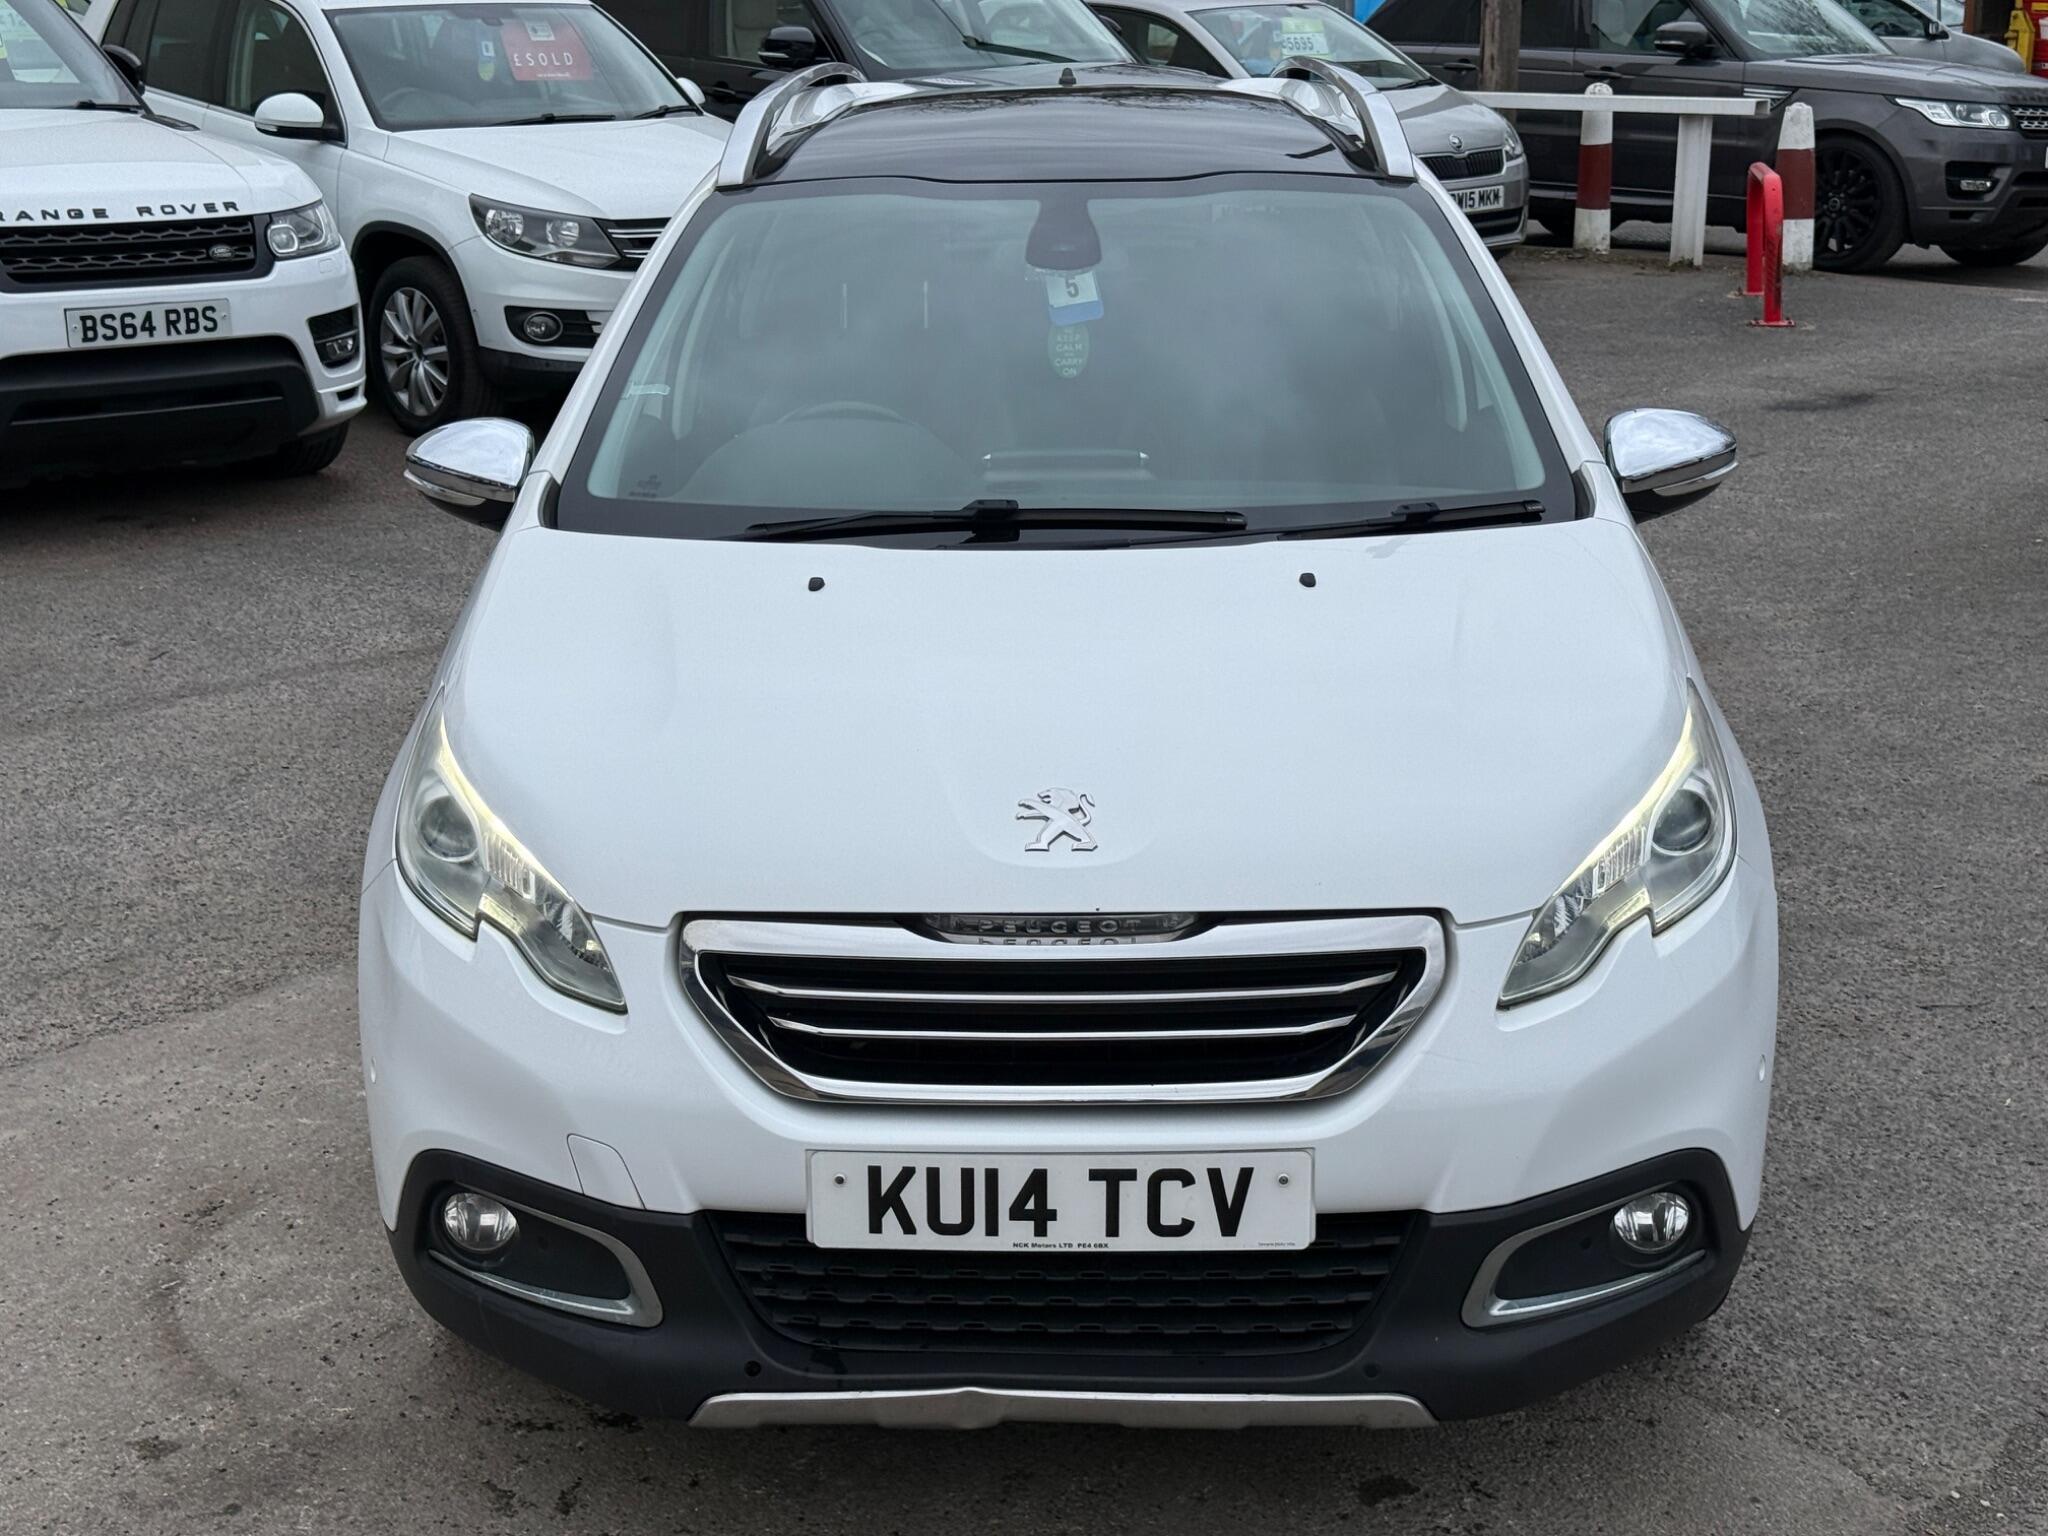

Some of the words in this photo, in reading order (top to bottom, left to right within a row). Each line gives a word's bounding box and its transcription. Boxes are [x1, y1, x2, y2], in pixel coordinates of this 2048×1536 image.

[1478, 188, 1500, 207] MKM
[0, 207, 109, 222] ANGE
[136, 201, 239, 217] ROVER
[1065, 276, 1080, 298] 5
[79, 311, 157, 343] BS64
[165, 305, 218, 336] RBS
[977, 919, 1142, 933] PEUGEOT
[867, 1165, 1058, 1237] KU14
[1088, 1167, 1255, 1238] TCV
